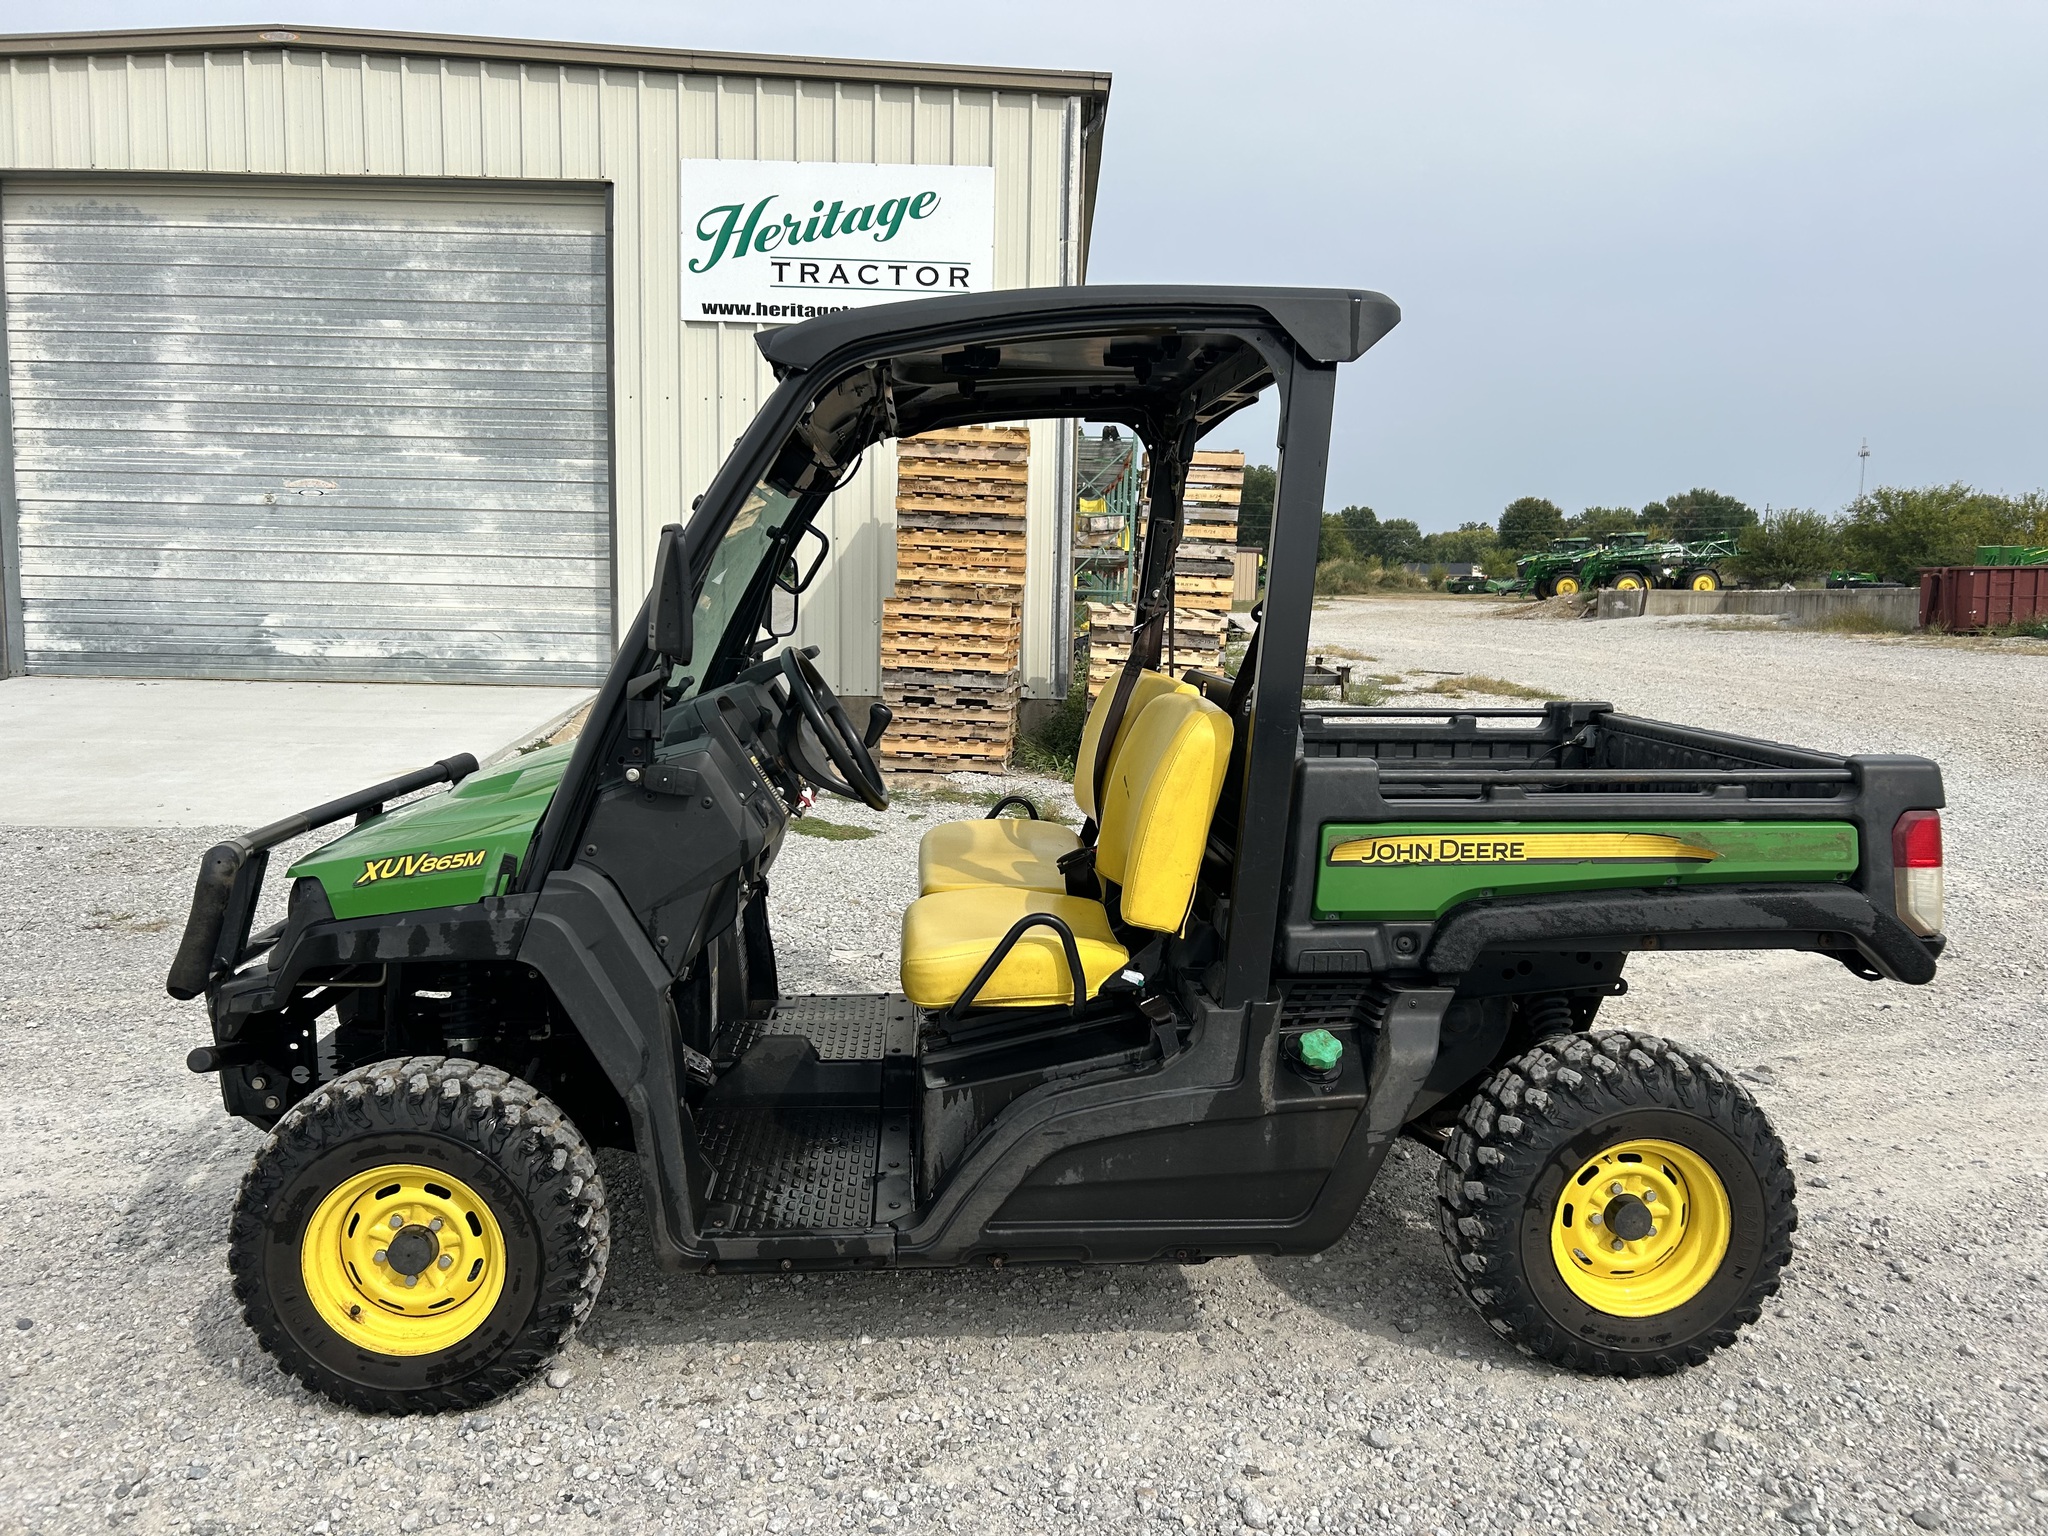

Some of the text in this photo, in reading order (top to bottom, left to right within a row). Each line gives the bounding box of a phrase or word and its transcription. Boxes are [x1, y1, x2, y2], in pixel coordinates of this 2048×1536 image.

[689, 191, 942, 274] Heritage
[771, 261, 971, 288] TRACTOR
[1361, 839, 1526, 861] JOHN DEERE
[355, 850, 486, 884] XUV865M
